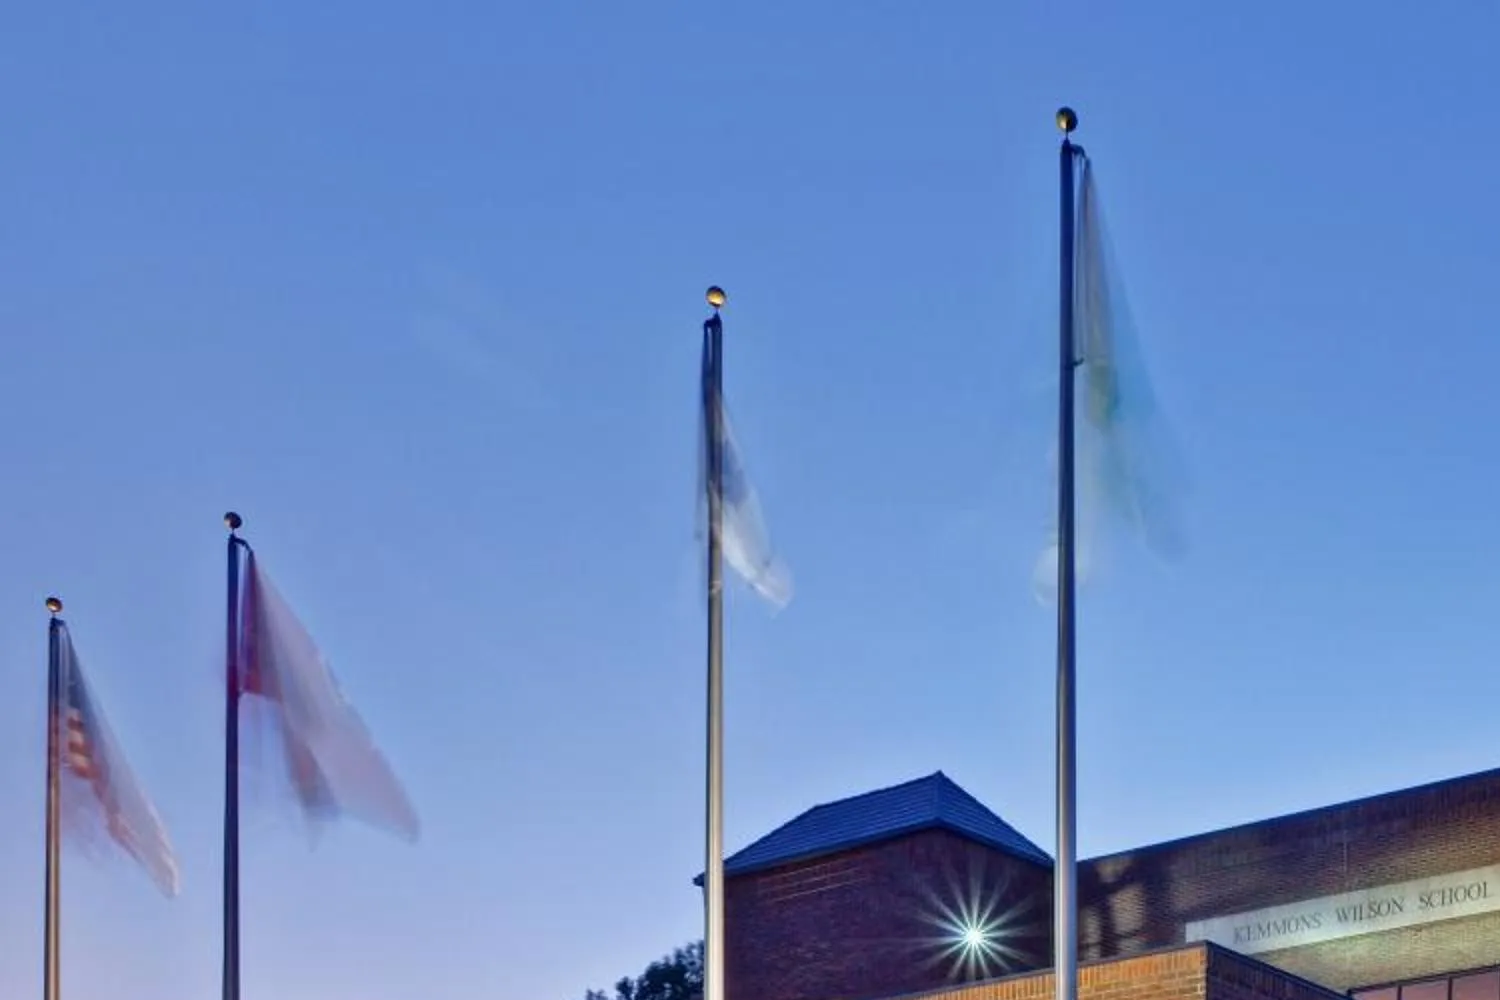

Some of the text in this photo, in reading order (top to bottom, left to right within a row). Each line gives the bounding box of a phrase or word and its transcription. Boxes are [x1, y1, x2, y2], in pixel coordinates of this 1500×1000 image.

[1234, 911, 1323, 944] KEMMONS
[1336, 896, 1405, 923] WILSON
[1419, 881, 1493, 910] SCHOOL
